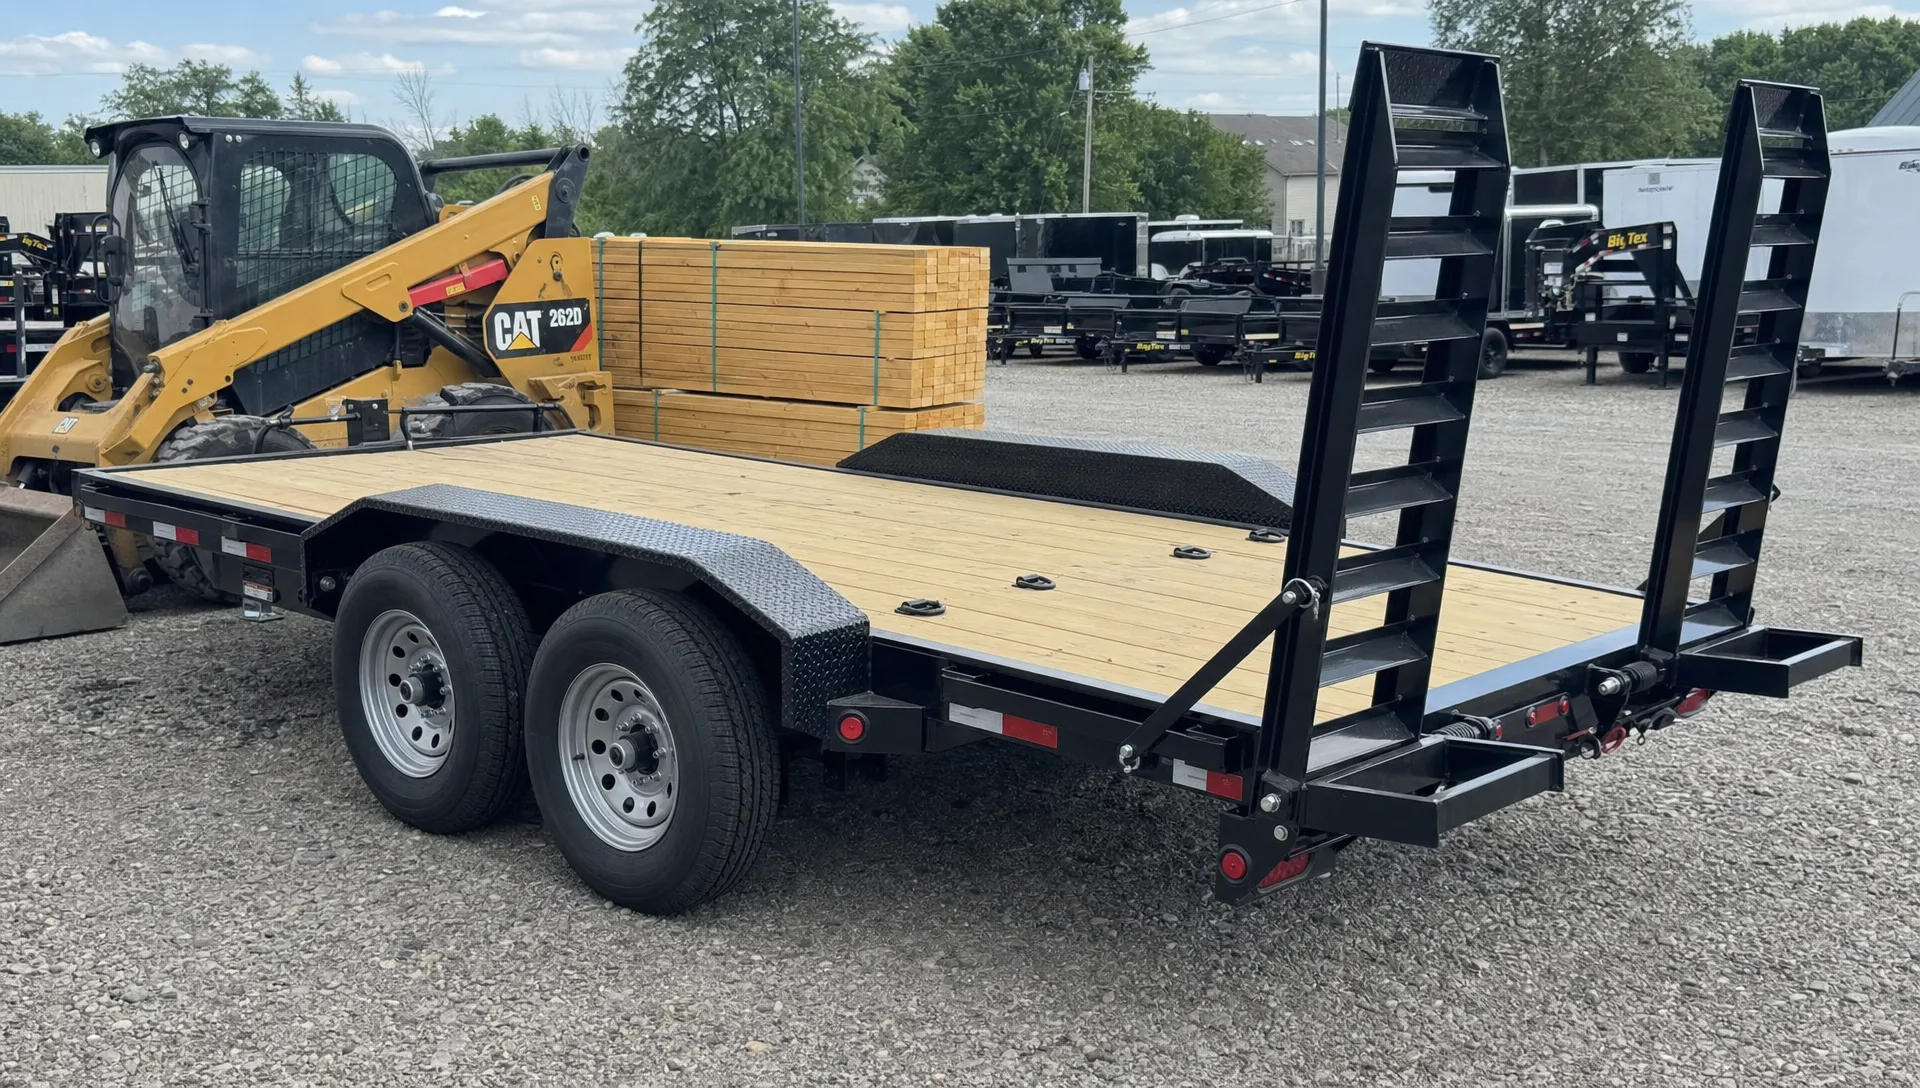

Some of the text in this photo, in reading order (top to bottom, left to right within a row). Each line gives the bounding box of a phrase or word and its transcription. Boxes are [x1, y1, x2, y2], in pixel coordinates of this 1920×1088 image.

[1608, 232, 1648, 249] Big Tex
[494, 307, 582, 351] CAT 262D
